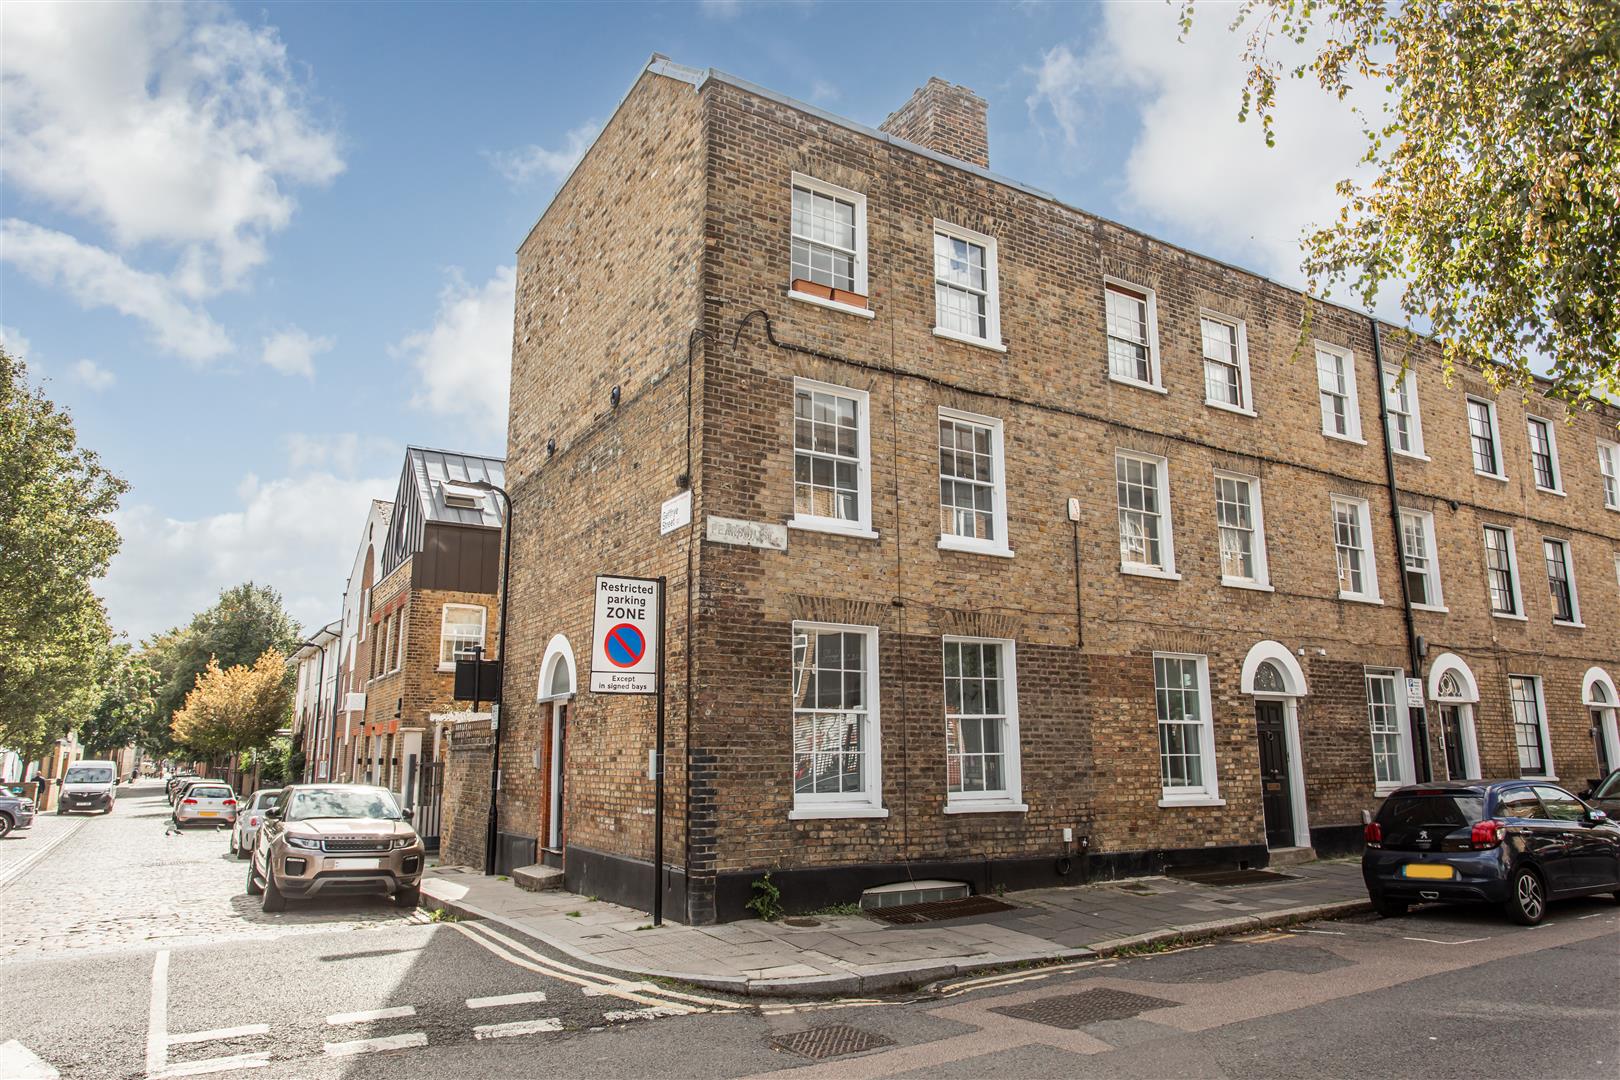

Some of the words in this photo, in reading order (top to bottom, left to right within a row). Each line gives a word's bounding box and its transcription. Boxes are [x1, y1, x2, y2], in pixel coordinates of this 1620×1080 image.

[601, 582, 653, 594] Restricted
[607, 595, 646, 607] parking
[606, 607, 646, 620] ZONE
